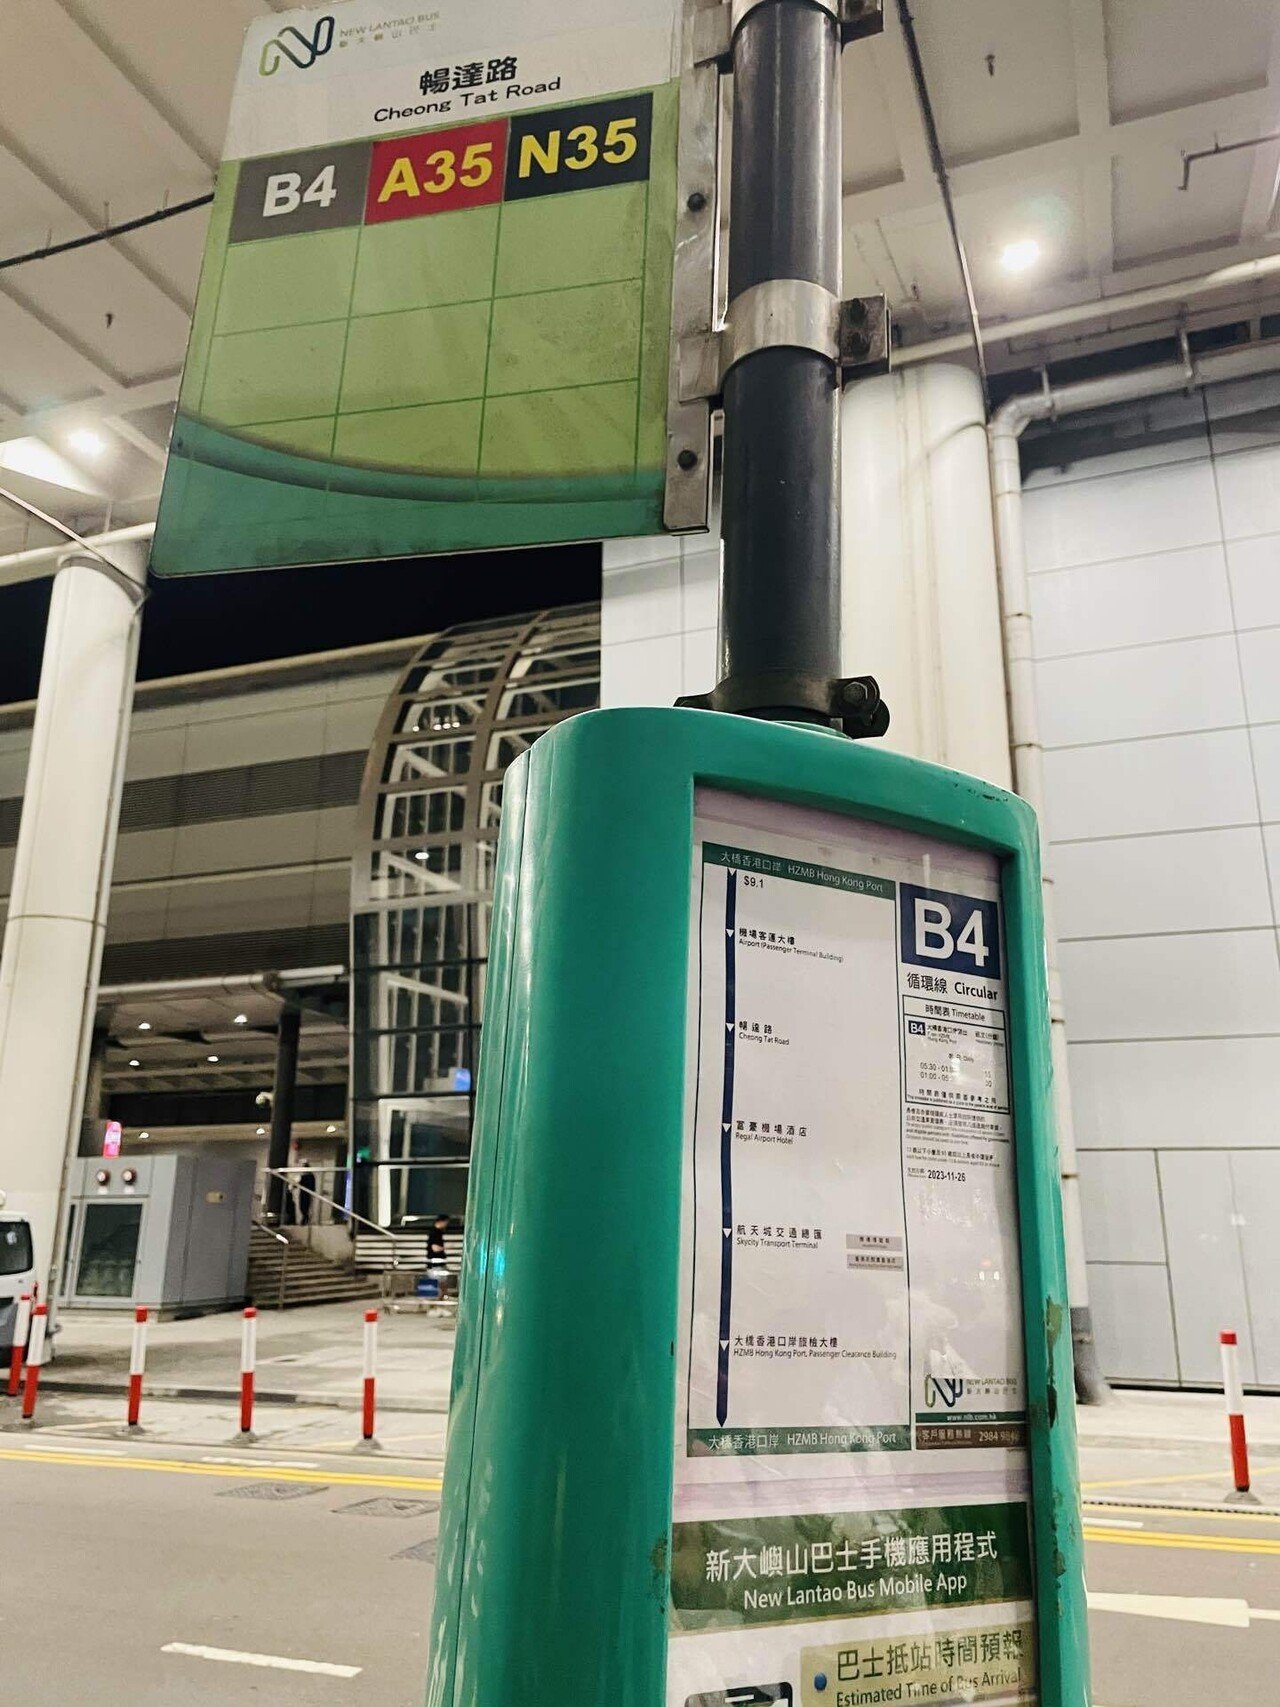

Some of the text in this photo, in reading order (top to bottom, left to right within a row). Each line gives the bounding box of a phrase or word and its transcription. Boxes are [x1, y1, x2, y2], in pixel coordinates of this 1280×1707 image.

[419, 56, 518, 96] 暢達路
[374, 77, 562, 122] Cheong Tat Road
[263, 117, 638, 217] B4 A35 N35
[721, 851, 884, 893] 大橋香港口岸 HZMB Hong Kong Port
[743, 875, 764, 889] $9.1
[914, 897, 989, 967] B4
[739, 938, 760, 948] Airport
[907, 972, 998, 1000] 循環線 Circular
[925, 1004, 986, 1021] 時間表 Timetable
[910, 1022, 924, 1034] B4
[739, 1032, 790, 1046] Cheong Tat Road
[736, 1121, 807, 1137] 富豪機場酒店
[736, 1132, 794, 1144] Regal Airport Hotel
[927, 1169, 966, 1182] 2023-11-26
[737, 1237, 819, 1249] Skycity Transport Terminal
[733, 1349, 754, 1357] HZMB
[755, 1349, 774, 1358] Hong
[774, 1349, 792, 1359] Kong
[809, 1350, 841, 1359] Passenger
[872, 1350, 897, 1359] Building
[708, 1431, 896, 1451] 大橋香港口岸 HZMB Hong Kong Port
[706, 1531, 998, 1582] 新大嶼山巴士手機應用程式
[744, 1572, 968, 1610] New Lantao Bus Mobile App
[838, 1630, 1024, 1682] 巴士抵站時間預報
[837, 1682, 902, 1707] Estimated
[906, 1682, 937, 1698] Time
[940, 1675, 954, 1692] of
[981, 1666, 1021, 1687] Arrival
